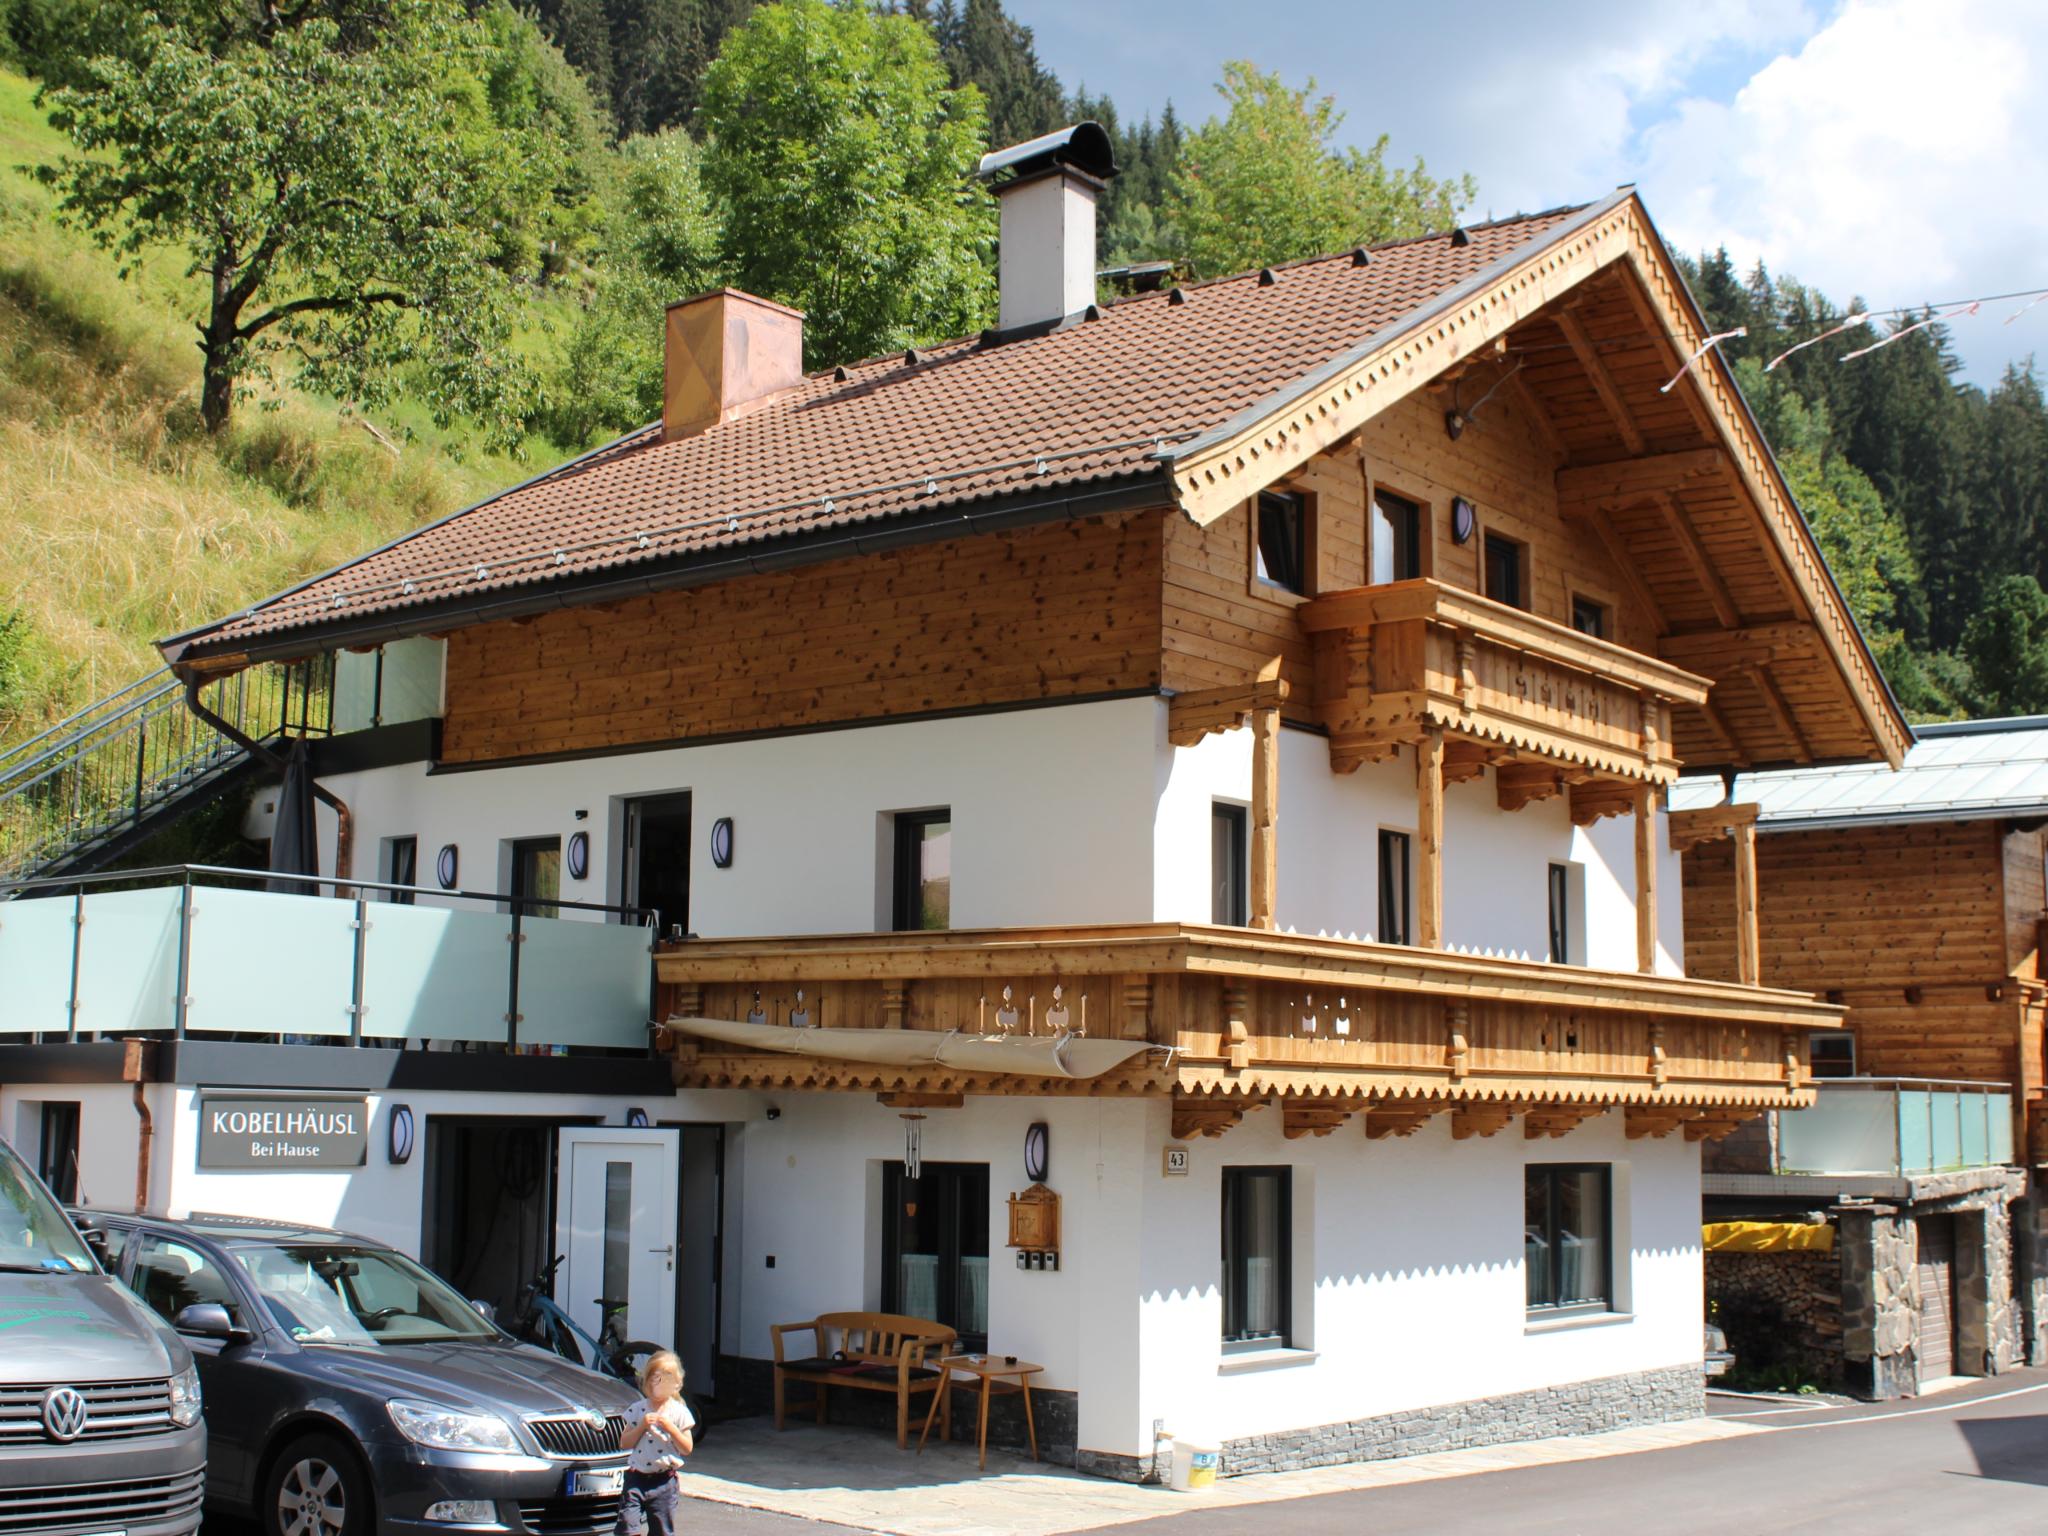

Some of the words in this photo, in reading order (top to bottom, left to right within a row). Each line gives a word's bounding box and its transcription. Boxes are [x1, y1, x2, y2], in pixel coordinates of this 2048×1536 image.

[213, 1107, 358, 1135] KOBELHÄUSL
[251, 1141, 273, 1157] Bei
[277, 1142, 320, 1157] Hause
[1170, 1153, 1184, 1166] 43
